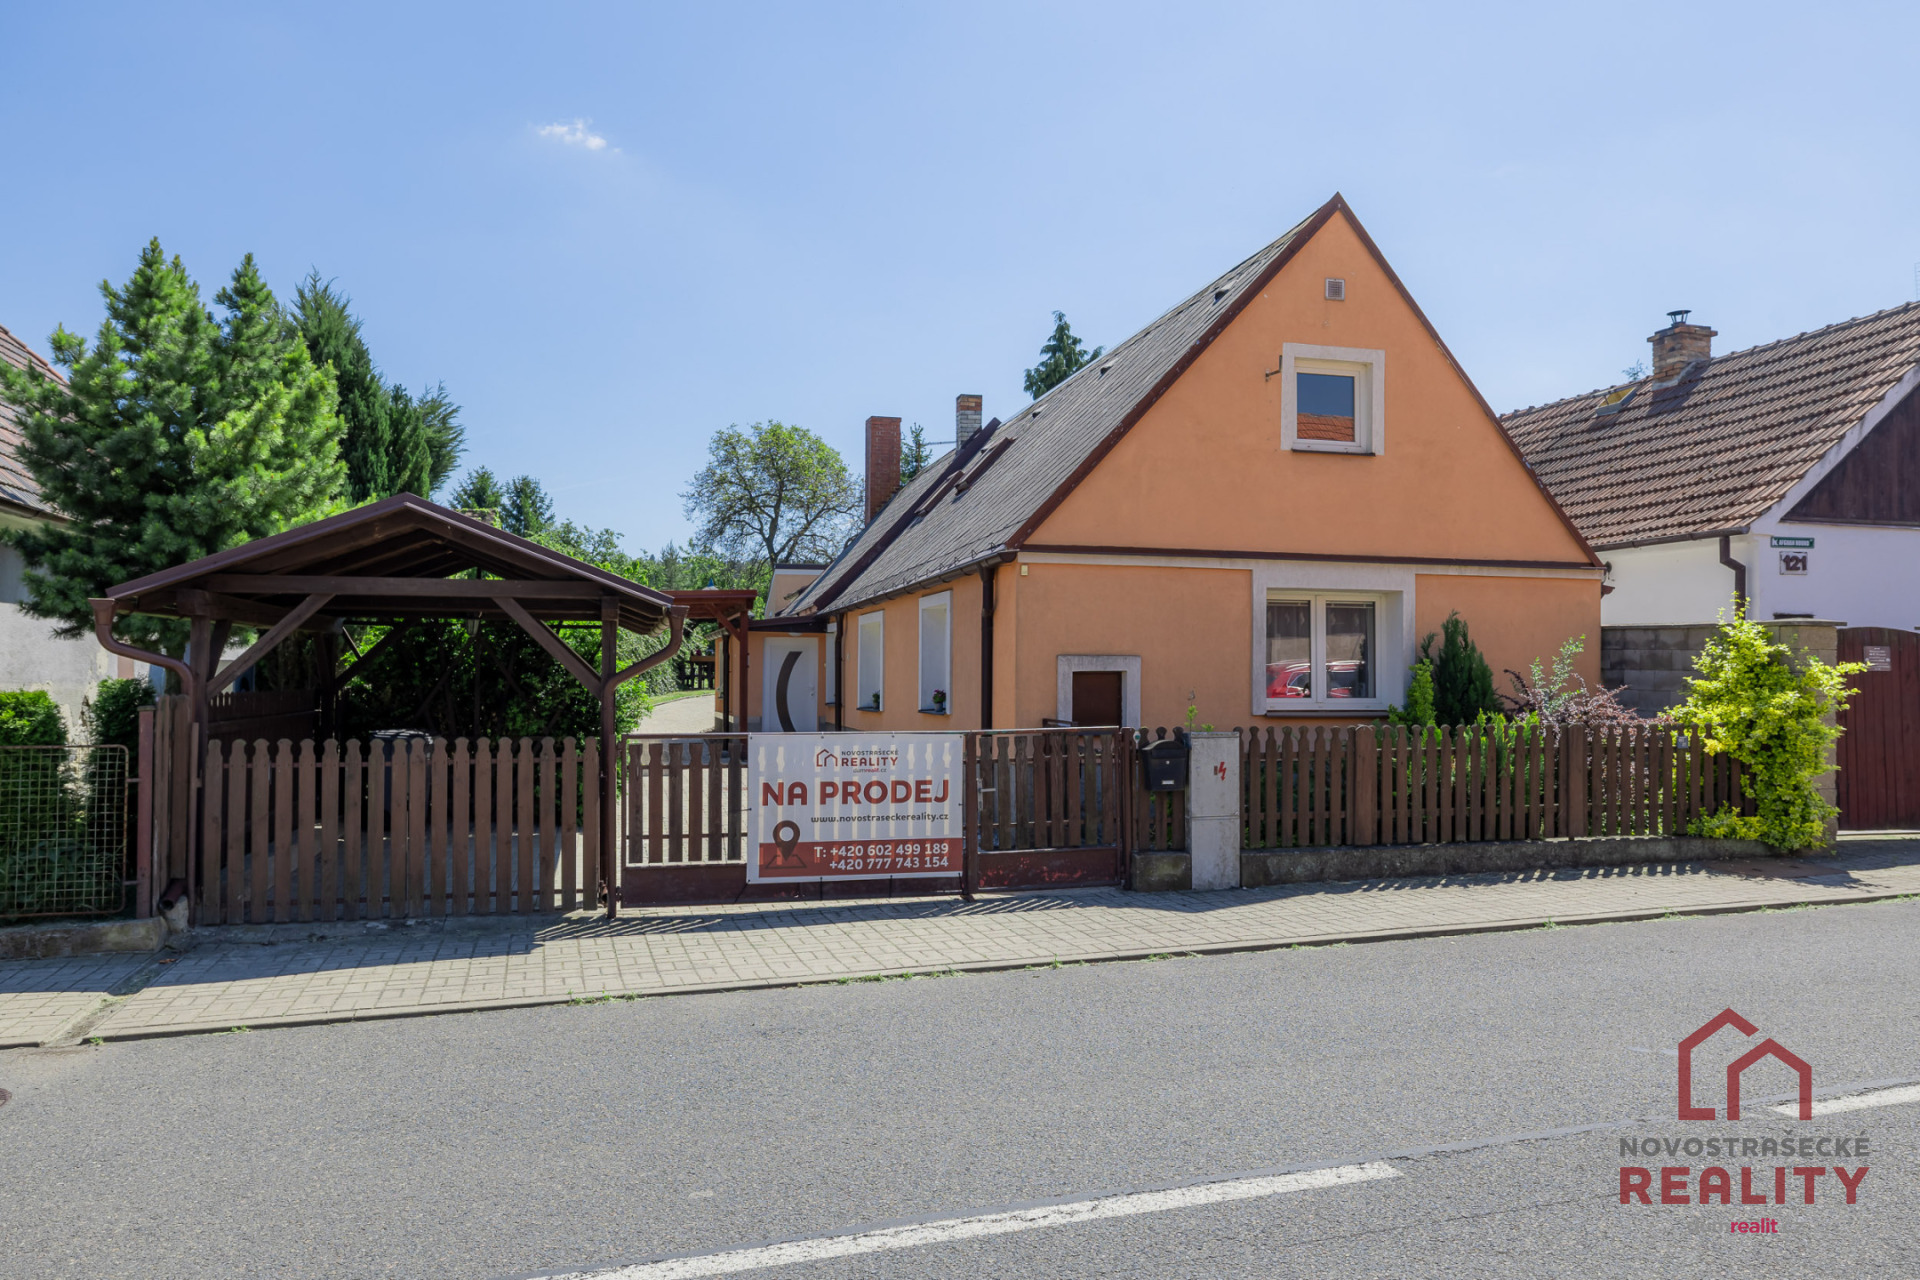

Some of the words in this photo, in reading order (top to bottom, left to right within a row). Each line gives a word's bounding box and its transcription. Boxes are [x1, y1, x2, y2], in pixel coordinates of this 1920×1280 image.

[1783, 555, 1807, 571] 121
[841, 757, 899, 767] REALITY
[762, 781, 808, 806] NA
[820, 779, 949, 805] PRODEJ
[811, 811, 949, 823] www.novostraseckereality.cz
[814, 846, 827, 858] T:
[830, 845, 864, 857] +420
[867, 844, 892, 856] 602
[896, 843, 921, 855] 499
[925, 842, 949, 854] 189
[829, 858, 864, 870] +420
[867, 858, 891, 870] 777
[896, 857, 920, 869] 743
[925, 856, 949, 868] 154
